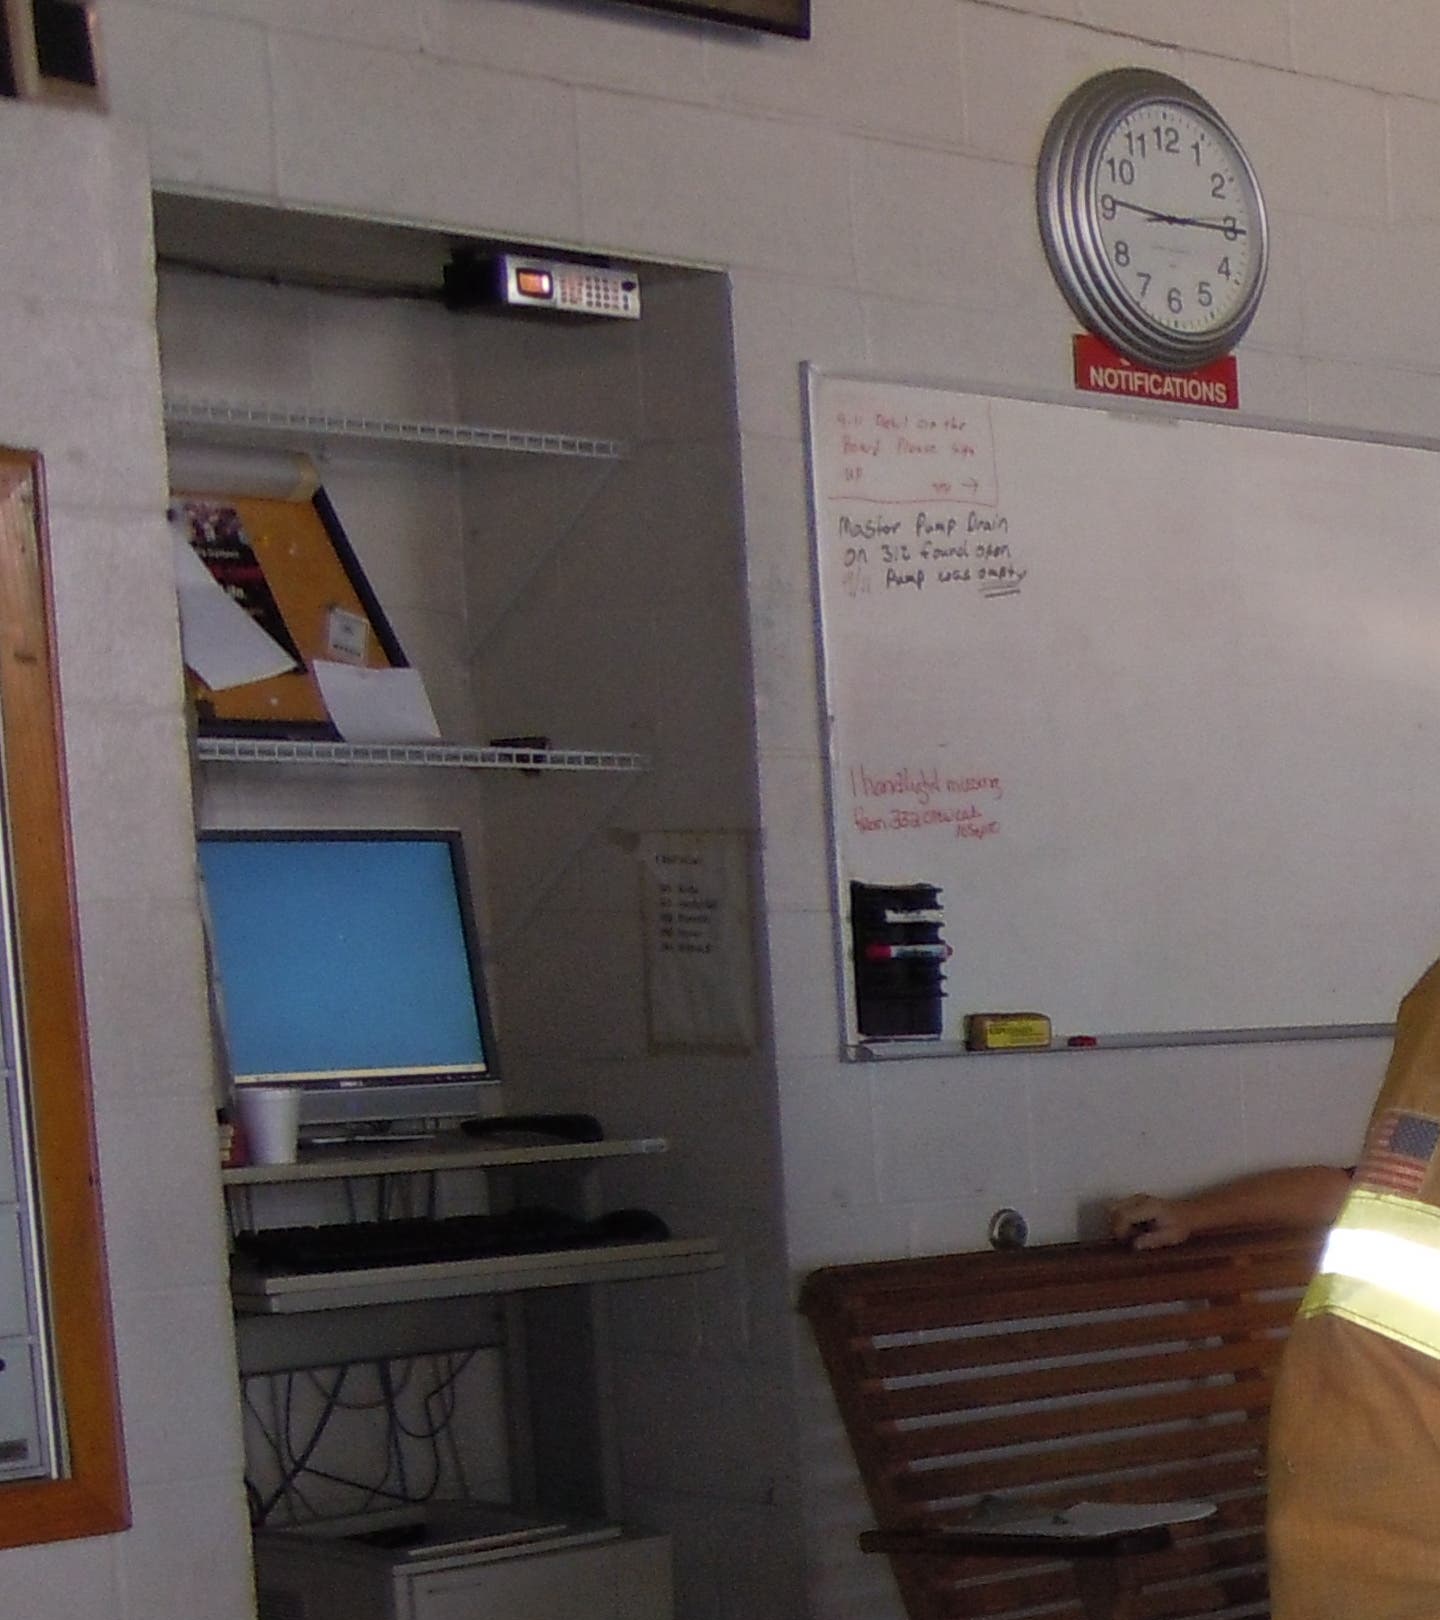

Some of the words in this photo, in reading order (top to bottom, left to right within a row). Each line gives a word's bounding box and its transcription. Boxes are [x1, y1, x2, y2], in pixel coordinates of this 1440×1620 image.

[1125, 131, 1146, 158] 11
[1153, 126, 1180, 153] 12
[1191, 141, 1200, 166] 1
[1107, 157, 1134, 185] 10
[1210, 172, 1226, 200] 2
[1101, 193, 1116, 220] 9
[1223, 216, 1238, 241] 3
[1115, 241, 1130, 267] 8
[1217, 256, 1231, 280] 4
[1136, 272, 1152, 297] 7
[1198, 282, 1213, 307] 5
[1167, 287, 1183, 314] 6
[1089, 365, 1228, 404] NOTIFICATIONS
[916, 511, 958, 537] Pump
[967, 510, 1009, 534] Drain
[919, 540, 969, 560] found
[938, 569, 971, 583] was
